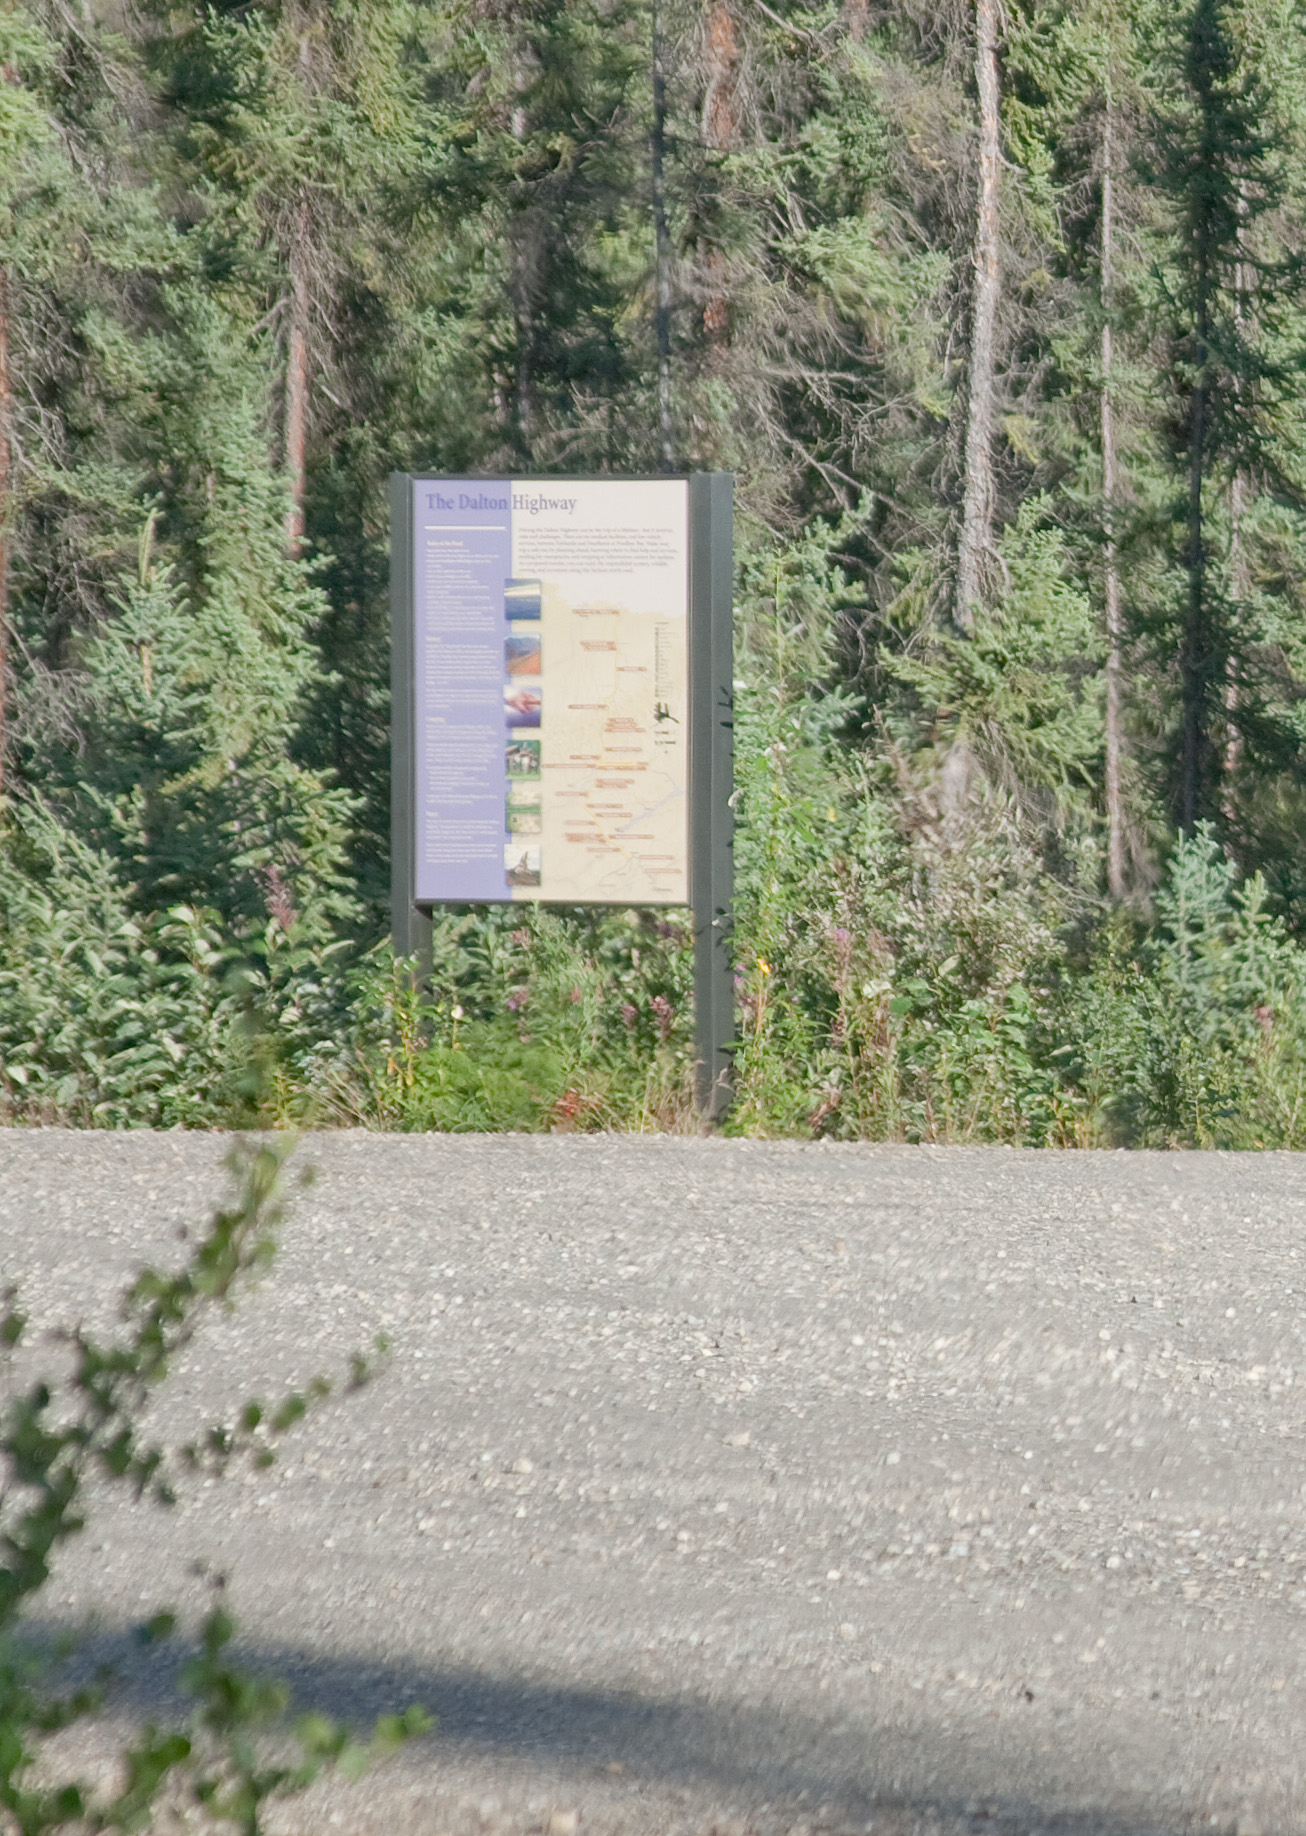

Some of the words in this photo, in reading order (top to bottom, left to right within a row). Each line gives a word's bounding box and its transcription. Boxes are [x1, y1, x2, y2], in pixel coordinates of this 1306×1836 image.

[425, 493, 454, 510] The
[458, 493, 508, 510] Dalton
[512, 494, 578, 515] Highway
